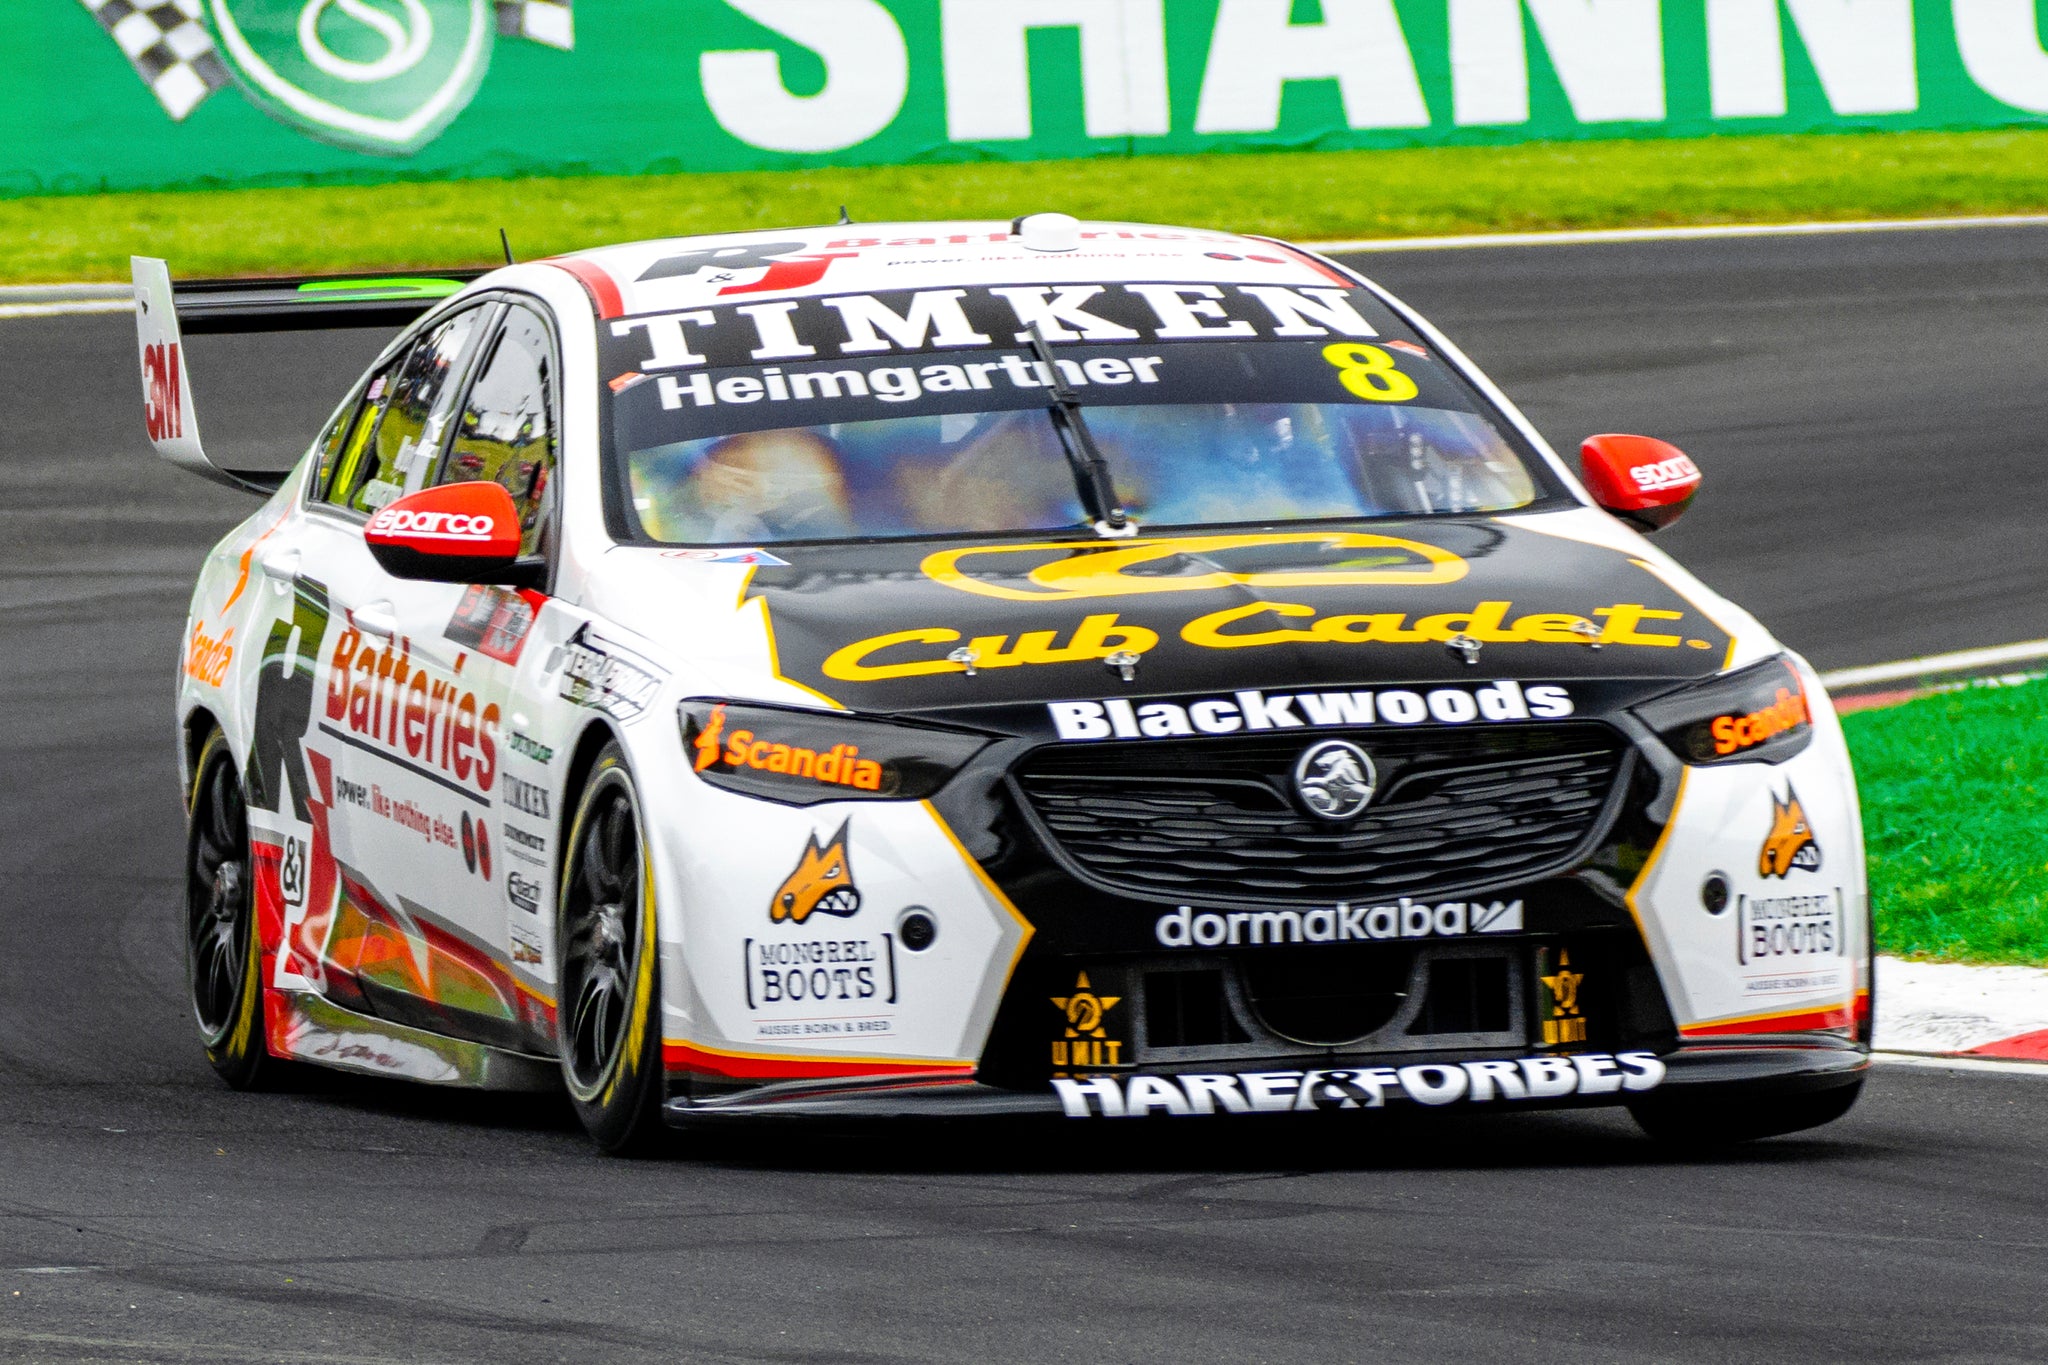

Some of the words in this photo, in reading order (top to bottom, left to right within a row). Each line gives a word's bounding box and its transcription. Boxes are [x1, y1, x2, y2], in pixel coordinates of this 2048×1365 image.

[699, 0, 2048, 153] SHANN
[612, 283, 1381, 371] TIMKEN
[143, 343, 183, 443] 3M
[657, 353, 1165, 411] Heimgartner
[1322, 343, 1420, 402] 8
[373, 509, 495, 538] sparco
[823, 613, 1160, 681] Cub
[1179, 600, 1684, 648] Cadet
[325, 607, 501, 791] Batteries
[1047, 681, 1574, 741] Blackwoods
[724, 728, 883, 791] Scandia
[1155, 896, 1468, 947] dormakaba
[1751, 920, 1835, 957] BOOTS
[760, 940, 876, 966] MONGREL
[763, 966, 877, 1002] BOOTS
[1051, 1041, 1122, 1066] UNIT
